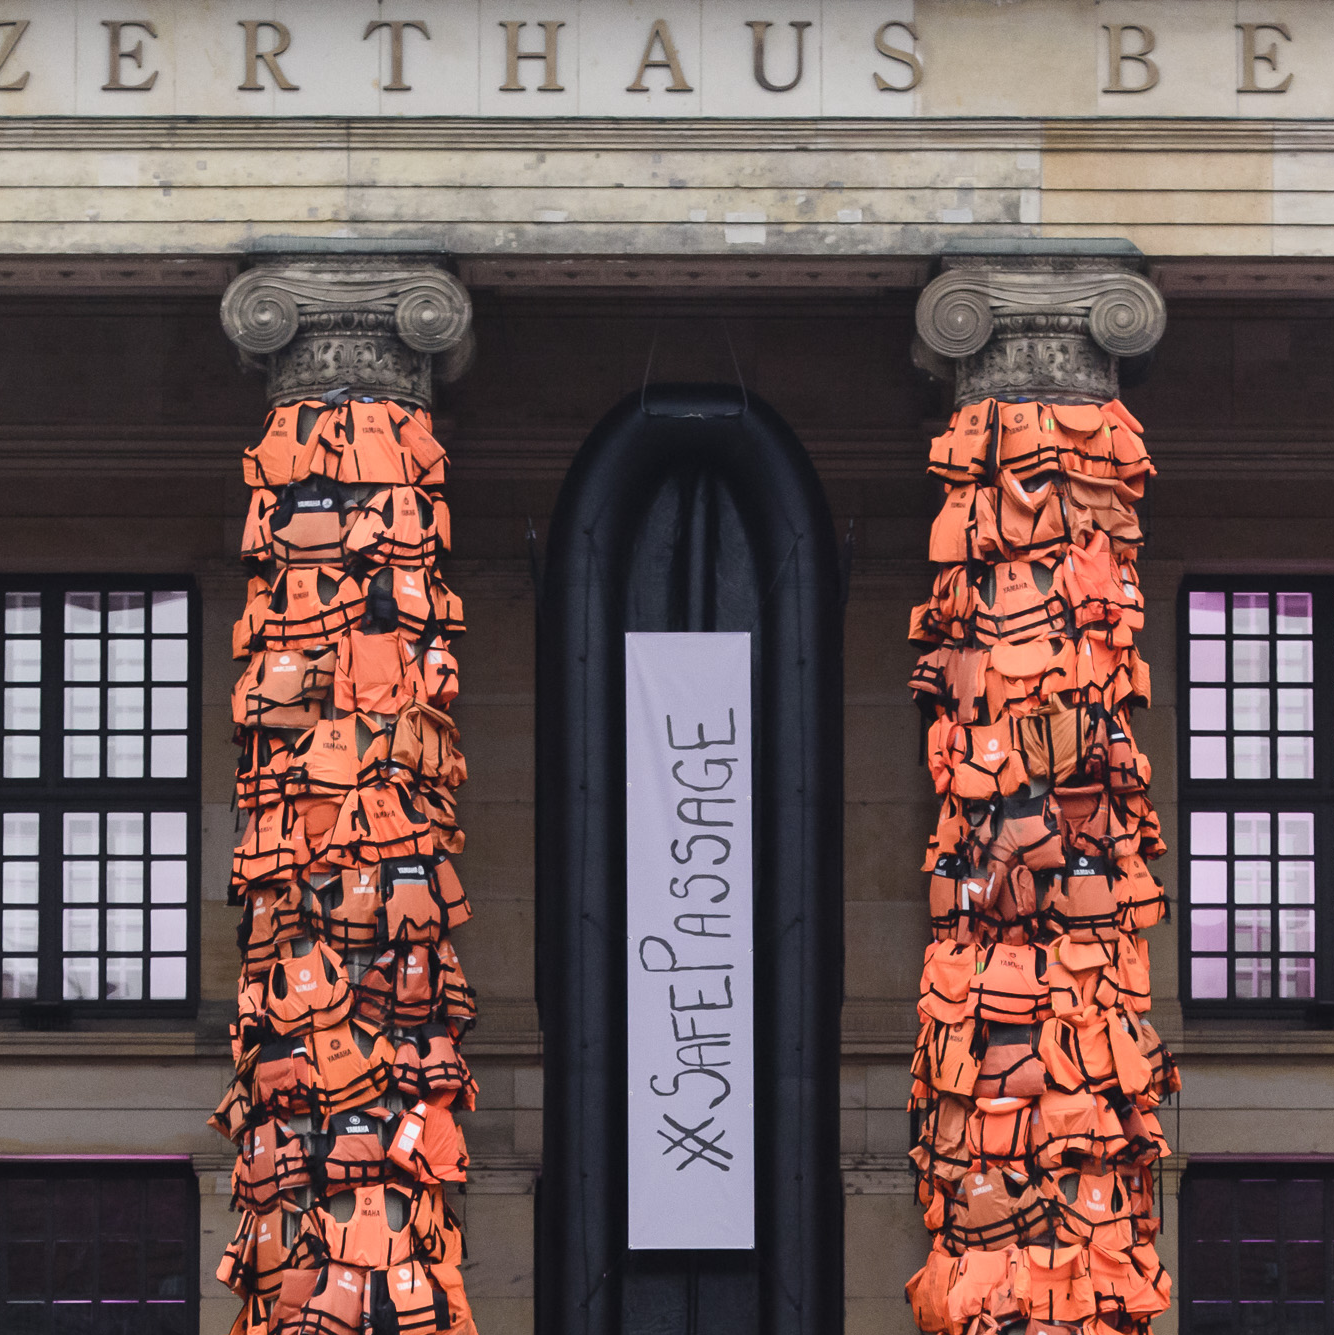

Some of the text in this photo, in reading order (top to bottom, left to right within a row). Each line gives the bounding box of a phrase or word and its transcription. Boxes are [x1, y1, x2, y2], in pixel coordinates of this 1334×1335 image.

[1003, 582, 1028, 593] YAMAHA
[323, 742, 348, 751] YAMAHA
[327, 1049, 352, 1063] YAMAHA
[346, 1125, 370, 1134] YAMAHA
